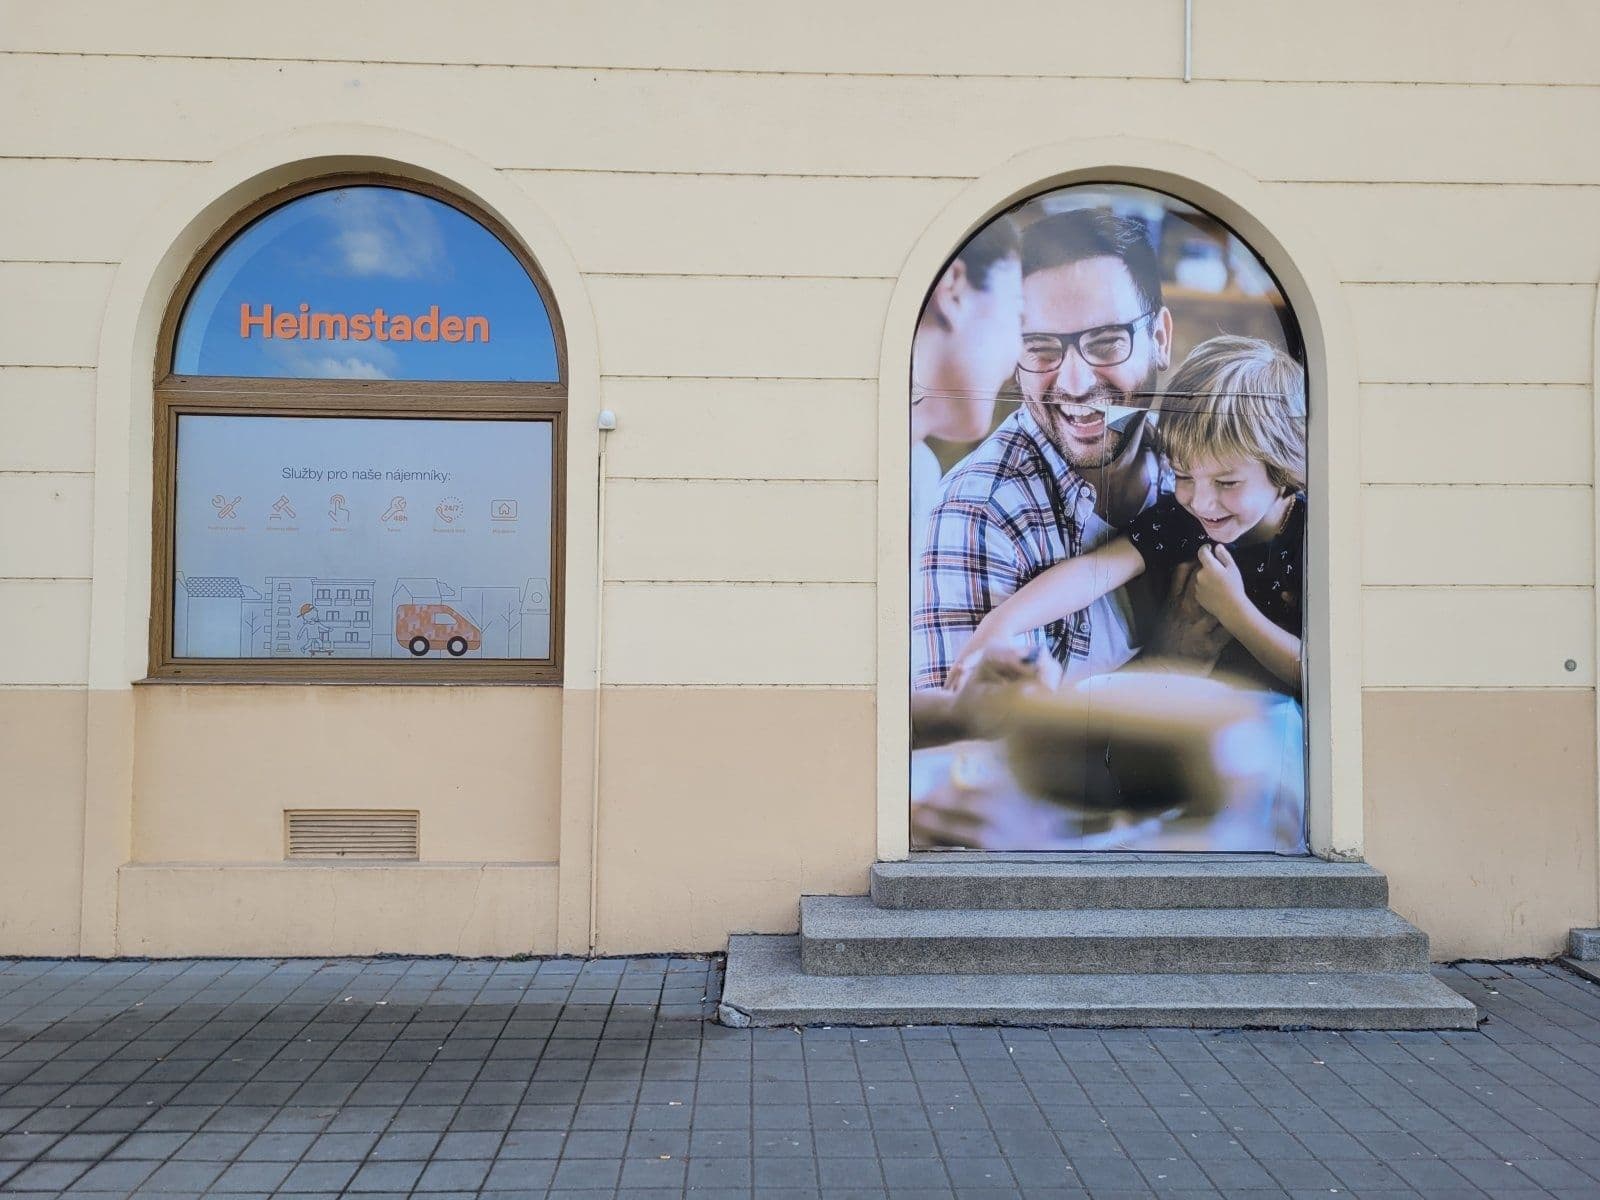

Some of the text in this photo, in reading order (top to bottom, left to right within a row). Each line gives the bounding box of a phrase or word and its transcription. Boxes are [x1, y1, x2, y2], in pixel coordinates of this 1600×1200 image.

[240, 303, 490, 343] Heimstaden
[281, 467, 451, 483] Služby pro naše nájemníky:
